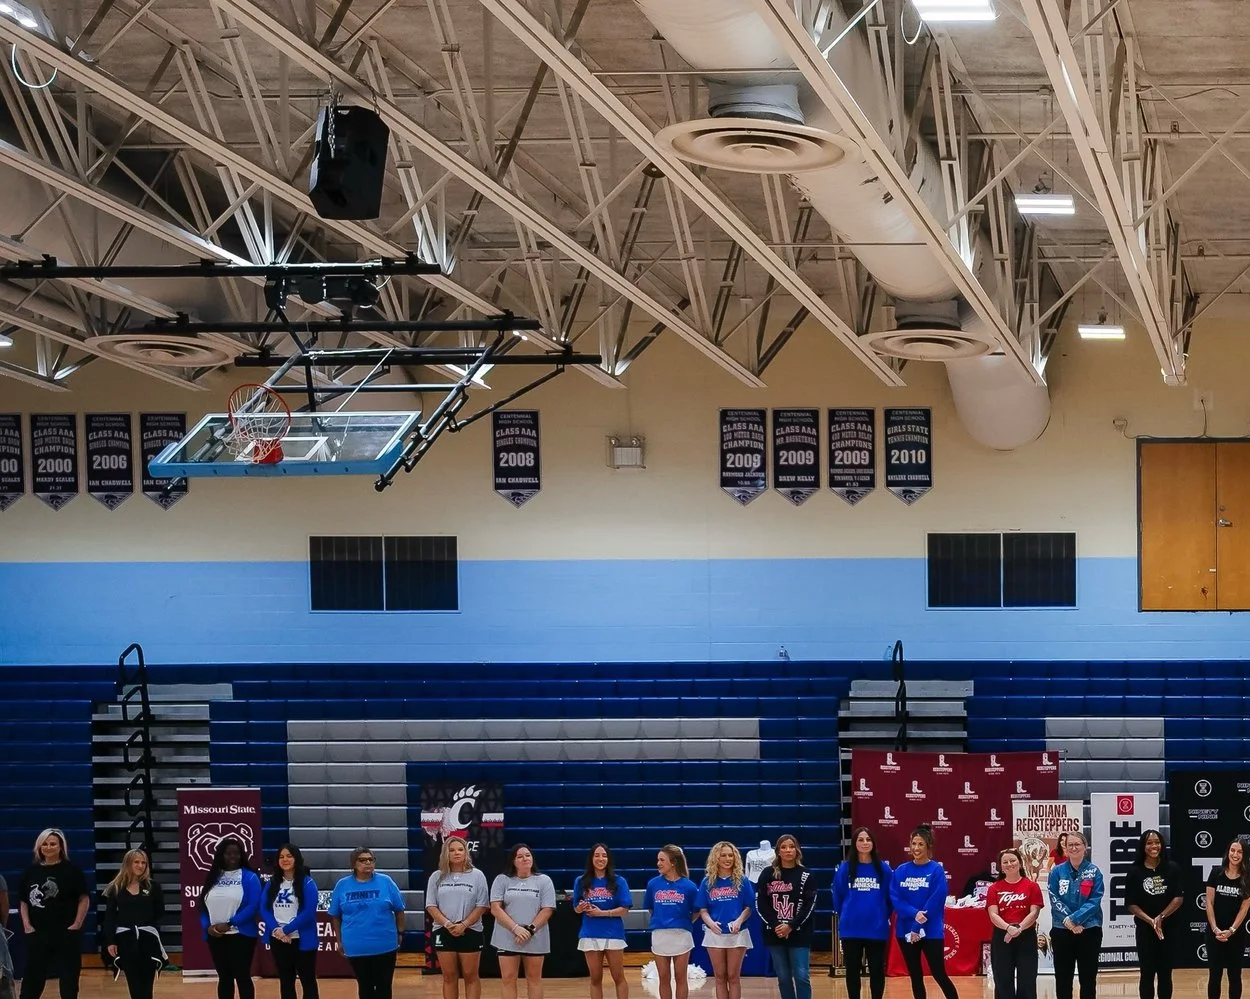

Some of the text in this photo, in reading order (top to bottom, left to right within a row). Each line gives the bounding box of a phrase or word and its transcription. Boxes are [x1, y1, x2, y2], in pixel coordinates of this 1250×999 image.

[496, 427, 537, 437] CLASS AAA
[723, 423, 764, 432] CLASS AAA
[776, 426, 817, 436] CLASS AAA
[831, 423, 872, 432] CLASS AAA
[887, 425, 928, 435] GIRLS STATE
[34, 429, 74, 437] CLASS AAA
[89, 430, 129, 440] CLASS AAA
[143, 430, 167, 439] CLASS
[34, 445, 75, 455] CHAMPION
[723, 440, 764, 450] CHAMPION
[831, 440, 873, 450] CHAMPIONS
[92, 455, 127, 469] 2006
[499, 452, 535, 466] 2008
[726, 453, 761, 468] 2009
[780, 451, 814, 465] 2009
[835, 451, 869, 465] 2009
[891, 450, 926, 464] 2010
[38, 459, 73, 473] 2000
[184, 805, 254, 814] Missouri State
[1028, 804, 1067, 817] INDIANA
[1016, 818, 1080, 832] REDSTEPPERS
[1216, 885, 1241, 894] ALABAM
[997, 892, 1027, 906] Tops
